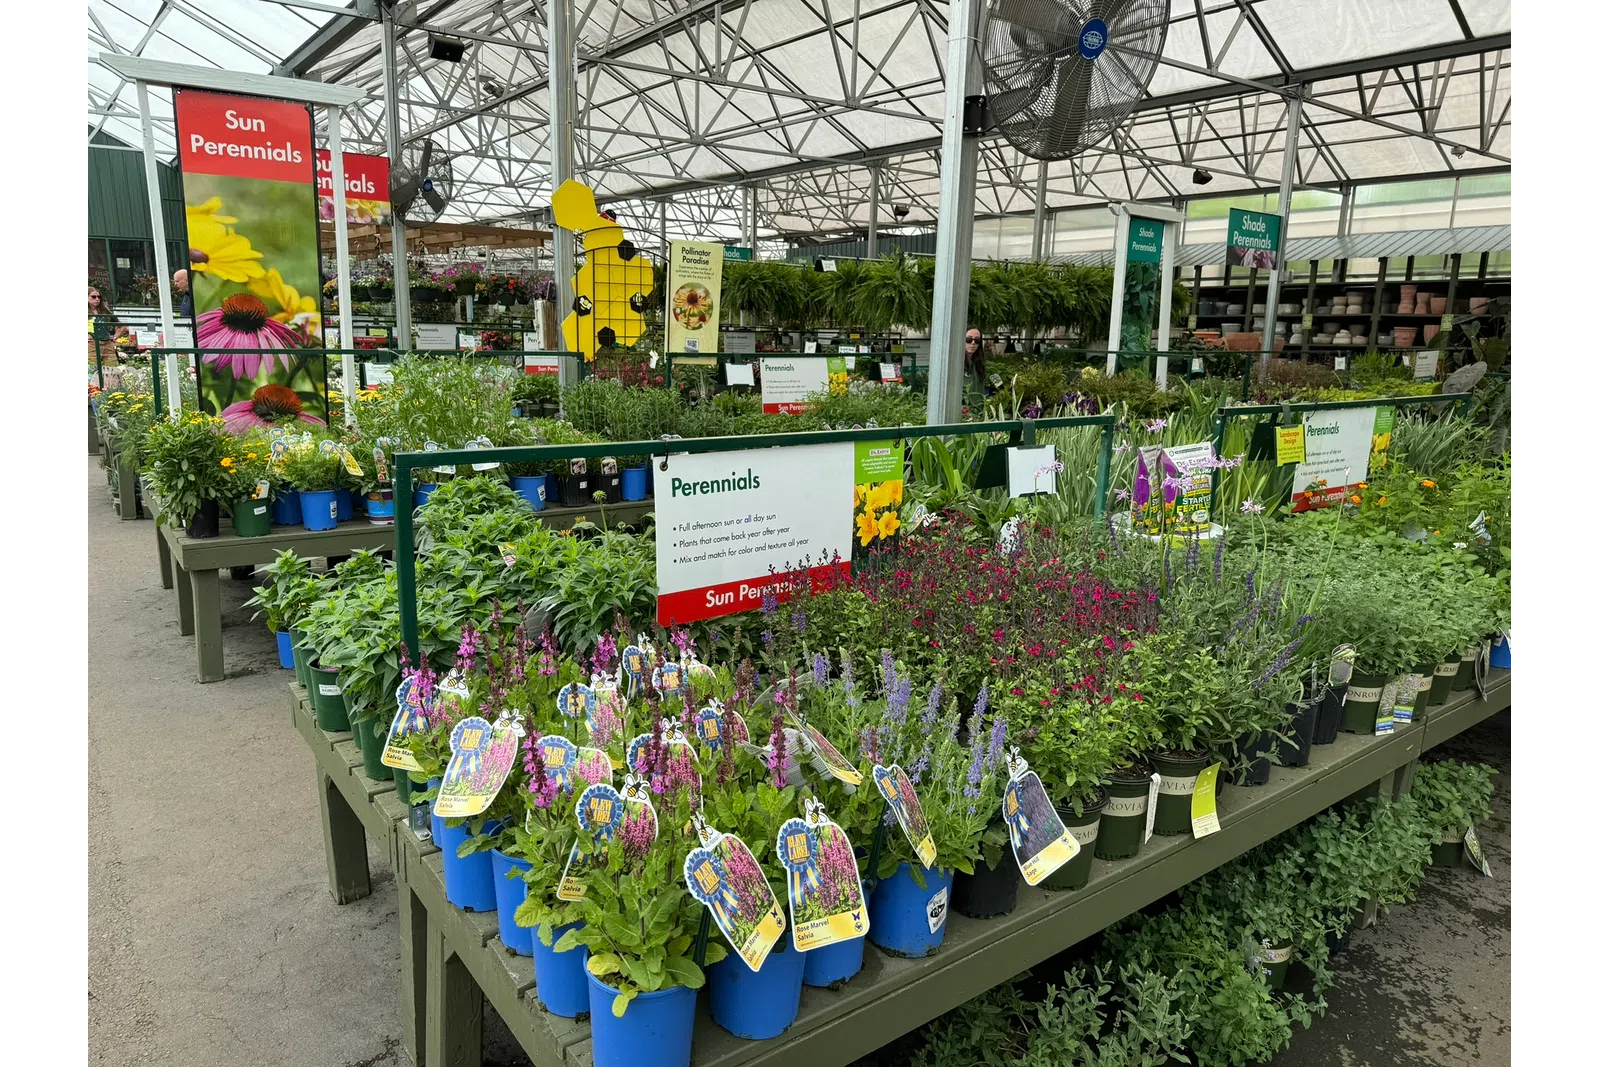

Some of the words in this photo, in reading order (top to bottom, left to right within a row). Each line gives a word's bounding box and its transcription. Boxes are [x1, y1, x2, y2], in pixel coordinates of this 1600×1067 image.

[225, 109, 266, 133] Sun
[190, 133, 303, 163] Perennials
[316, 153, 332, 173] Su
[1241, 214, 1266, 233] Shade
[1138, 227, 1155, 238] Shade
[1232, 230, 1272, 249] Perennials
[681, 246, 712, 257] Pollinator
[724, 248, 741, 258] hade
[1131, 241, 1157, 252] Perennials
[682, 255, 710, 266] Paradise
[764, 363, 795, 372] Perennials
[777, 403, 789, 412] Sun
[1306, 421, 1340, 437] Perennials
[671, 468, 760, 498] Perennials
[678, 522, 691, 532] Full
[691, 520, 722, 531] afternoon
[723, 519, 735, 527] sun
[743, 514, 752, 524] all
[752, 513, 765, 524] day
[765, 513, 777, 521] sun
[679, 539, 698, 549] Plants
[699, 536, 712, 545] that
[713, 535, 730, 544] come
[730, 530, 747, 541] back
[747, 531, 761, 540] year
[761, 526, 776, 536] after
[776, 526, 791, 536] year
[679, 555, 693, 564] Mix
[693, 551, 707, 562] and
[707, 549, 727, 560] match
[727, 547, 737, 556] for
[737, 545, 754, 555] color
[754, 542, 767, 553] and
[767, 541, 787, 550] texture
[787, 538, 796, 547] all
[796, 538, 810, 547] year
[705, 589, 735, 608] Sun
[1346, 689, 1379, 699] ONROV
[386, 753, 402, 761] Salvia
[387, 746, 401, 755] Rose
[401, 749, 413, 757] Mar
[1160, 781, 1187, 791] OVIA
[440, 794, 452, 802] Rose
[452, 795, 470, 803] Marvel
[1107, 802, 1143, 812] ROVIA
[593, 809, 612, 824] ABEL
[788, 845, 811, 861] LABEL
[1022, 861, 1034, 871] Blue
[1031, 855, 1040, 865] Hill
[1026, 867, 1039, 878] Sage
[796, 924, 810, 934] Rose
[810, 918, 830, 930] Marvel
[797, 931, 815, 942] Salvia
